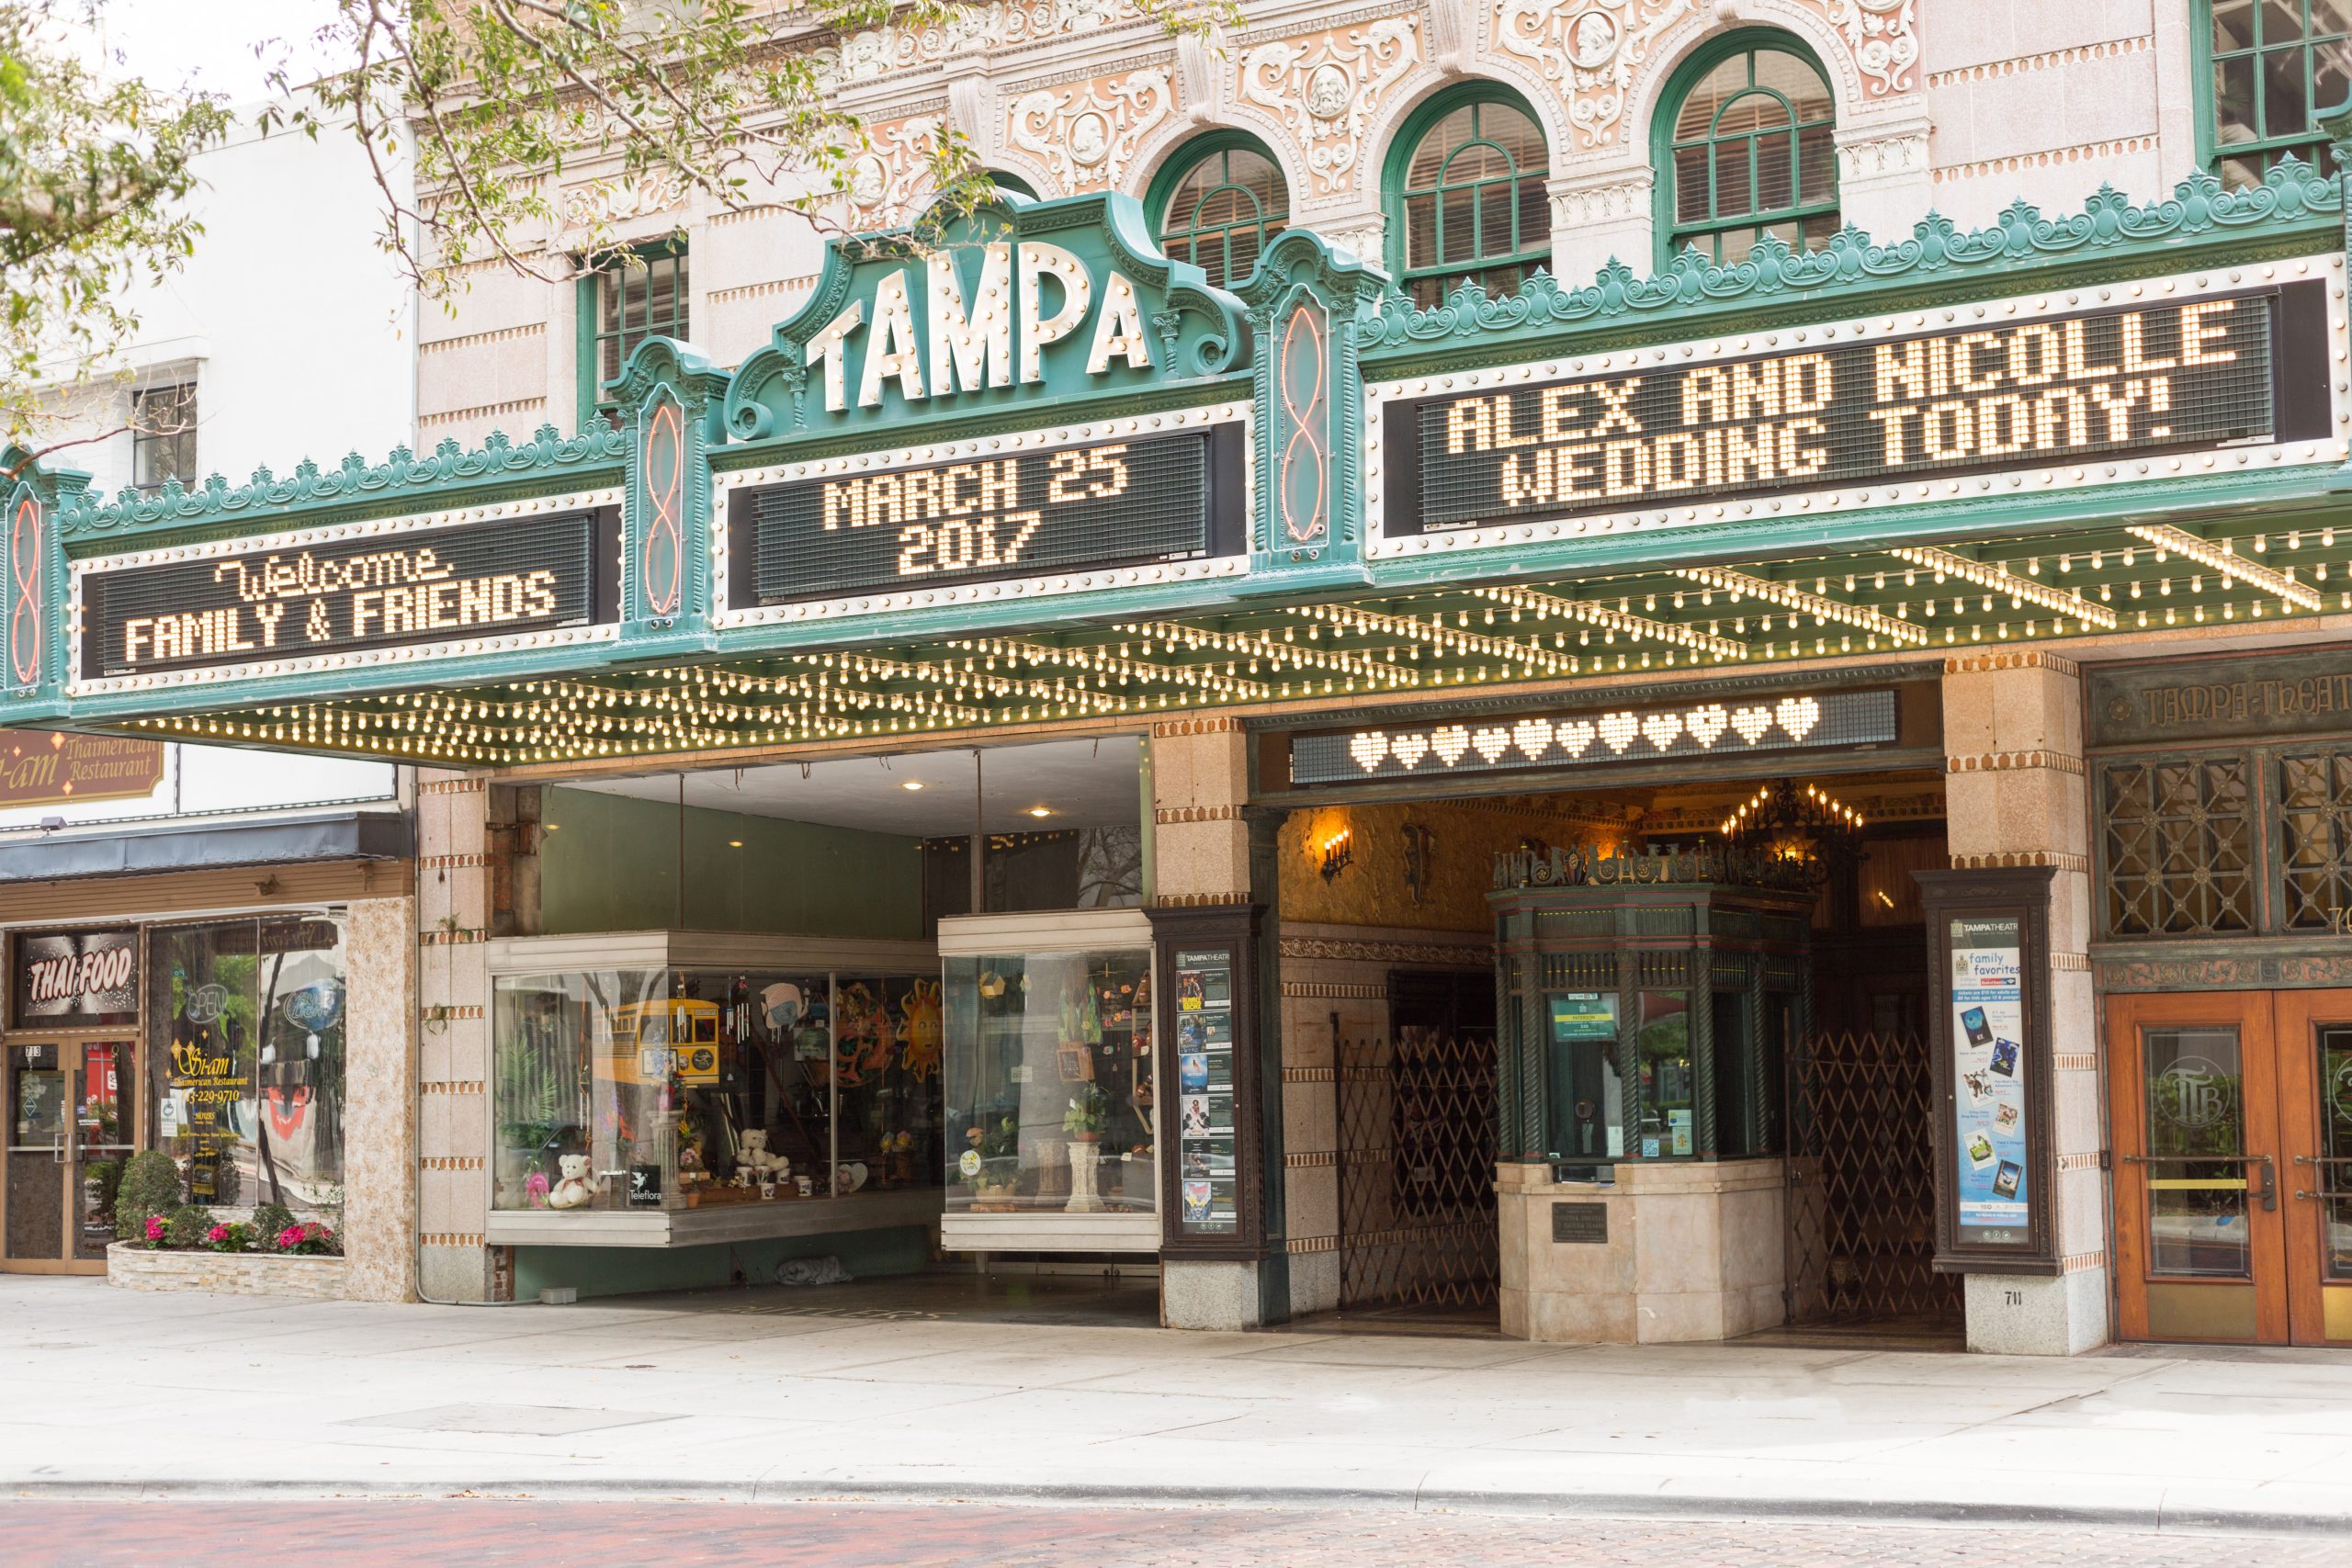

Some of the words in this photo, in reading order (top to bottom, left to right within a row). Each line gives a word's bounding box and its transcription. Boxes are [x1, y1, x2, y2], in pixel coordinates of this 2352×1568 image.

[807, 242, 1155, 412] TAMPA
[1449, 377, 1642, 454] ALEX
[1682, 354, 1832, 425] AND
[1876, 301, 2236, 401] NICOLLE
[1502, 418, 1826, 506] WEDDING
[1871, 377, 2170, 465] TODAY!
[824, 459, 1017, 530] MARCH
[1050, 445, 1128, 502] 25
[899, 511, 1040, 575] 2017
[215, 548, 454, 602] Welcome
[125, 603, 284, 662] FAMILY
[306, 598, 331, 641] &
[353, 570, 555, 637] FRIENDS
[2143, 682, 2249, 728] TAMPA
[65, 736, 156, 761] Thaimerican
[70, 755, 152, 782] Restaurant
[1969, 953, 2004, 965] family
[1973, 964, 2021, 976] favorites
[30, 954, 77, 1002] THAI
[79, 946, 132, 995] FOOD
[188, 991, 226, 1017] OPEN
[26, 1047, 40, 1056] 713
[178, 1046, 229, 1077] Si-am
[183, 1089, 239, 1104] 13-229-9710
[213, 1077, 248, 1087] Restaurant
[629, 1190, 662, 1200] Teleflora
[2005, 1291, 2022, 1305] 711
